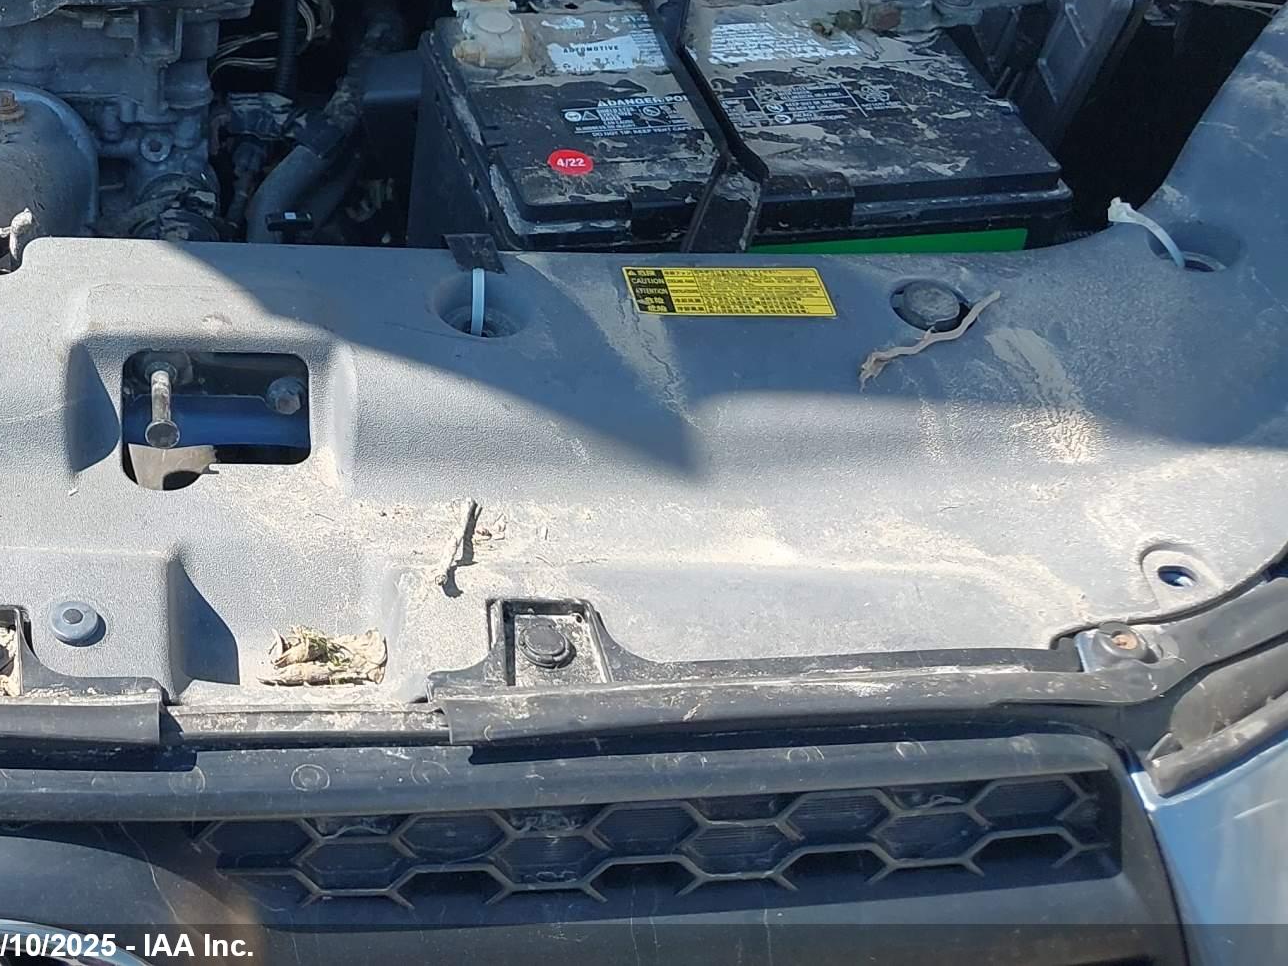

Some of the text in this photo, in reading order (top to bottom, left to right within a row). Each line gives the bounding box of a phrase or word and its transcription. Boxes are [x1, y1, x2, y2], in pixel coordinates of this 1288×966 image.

[607, 94, 689, 107] DANGER/POI
[556, 157, 586, 168] 4/22
[630, 277, 665, 285] CAUTION
